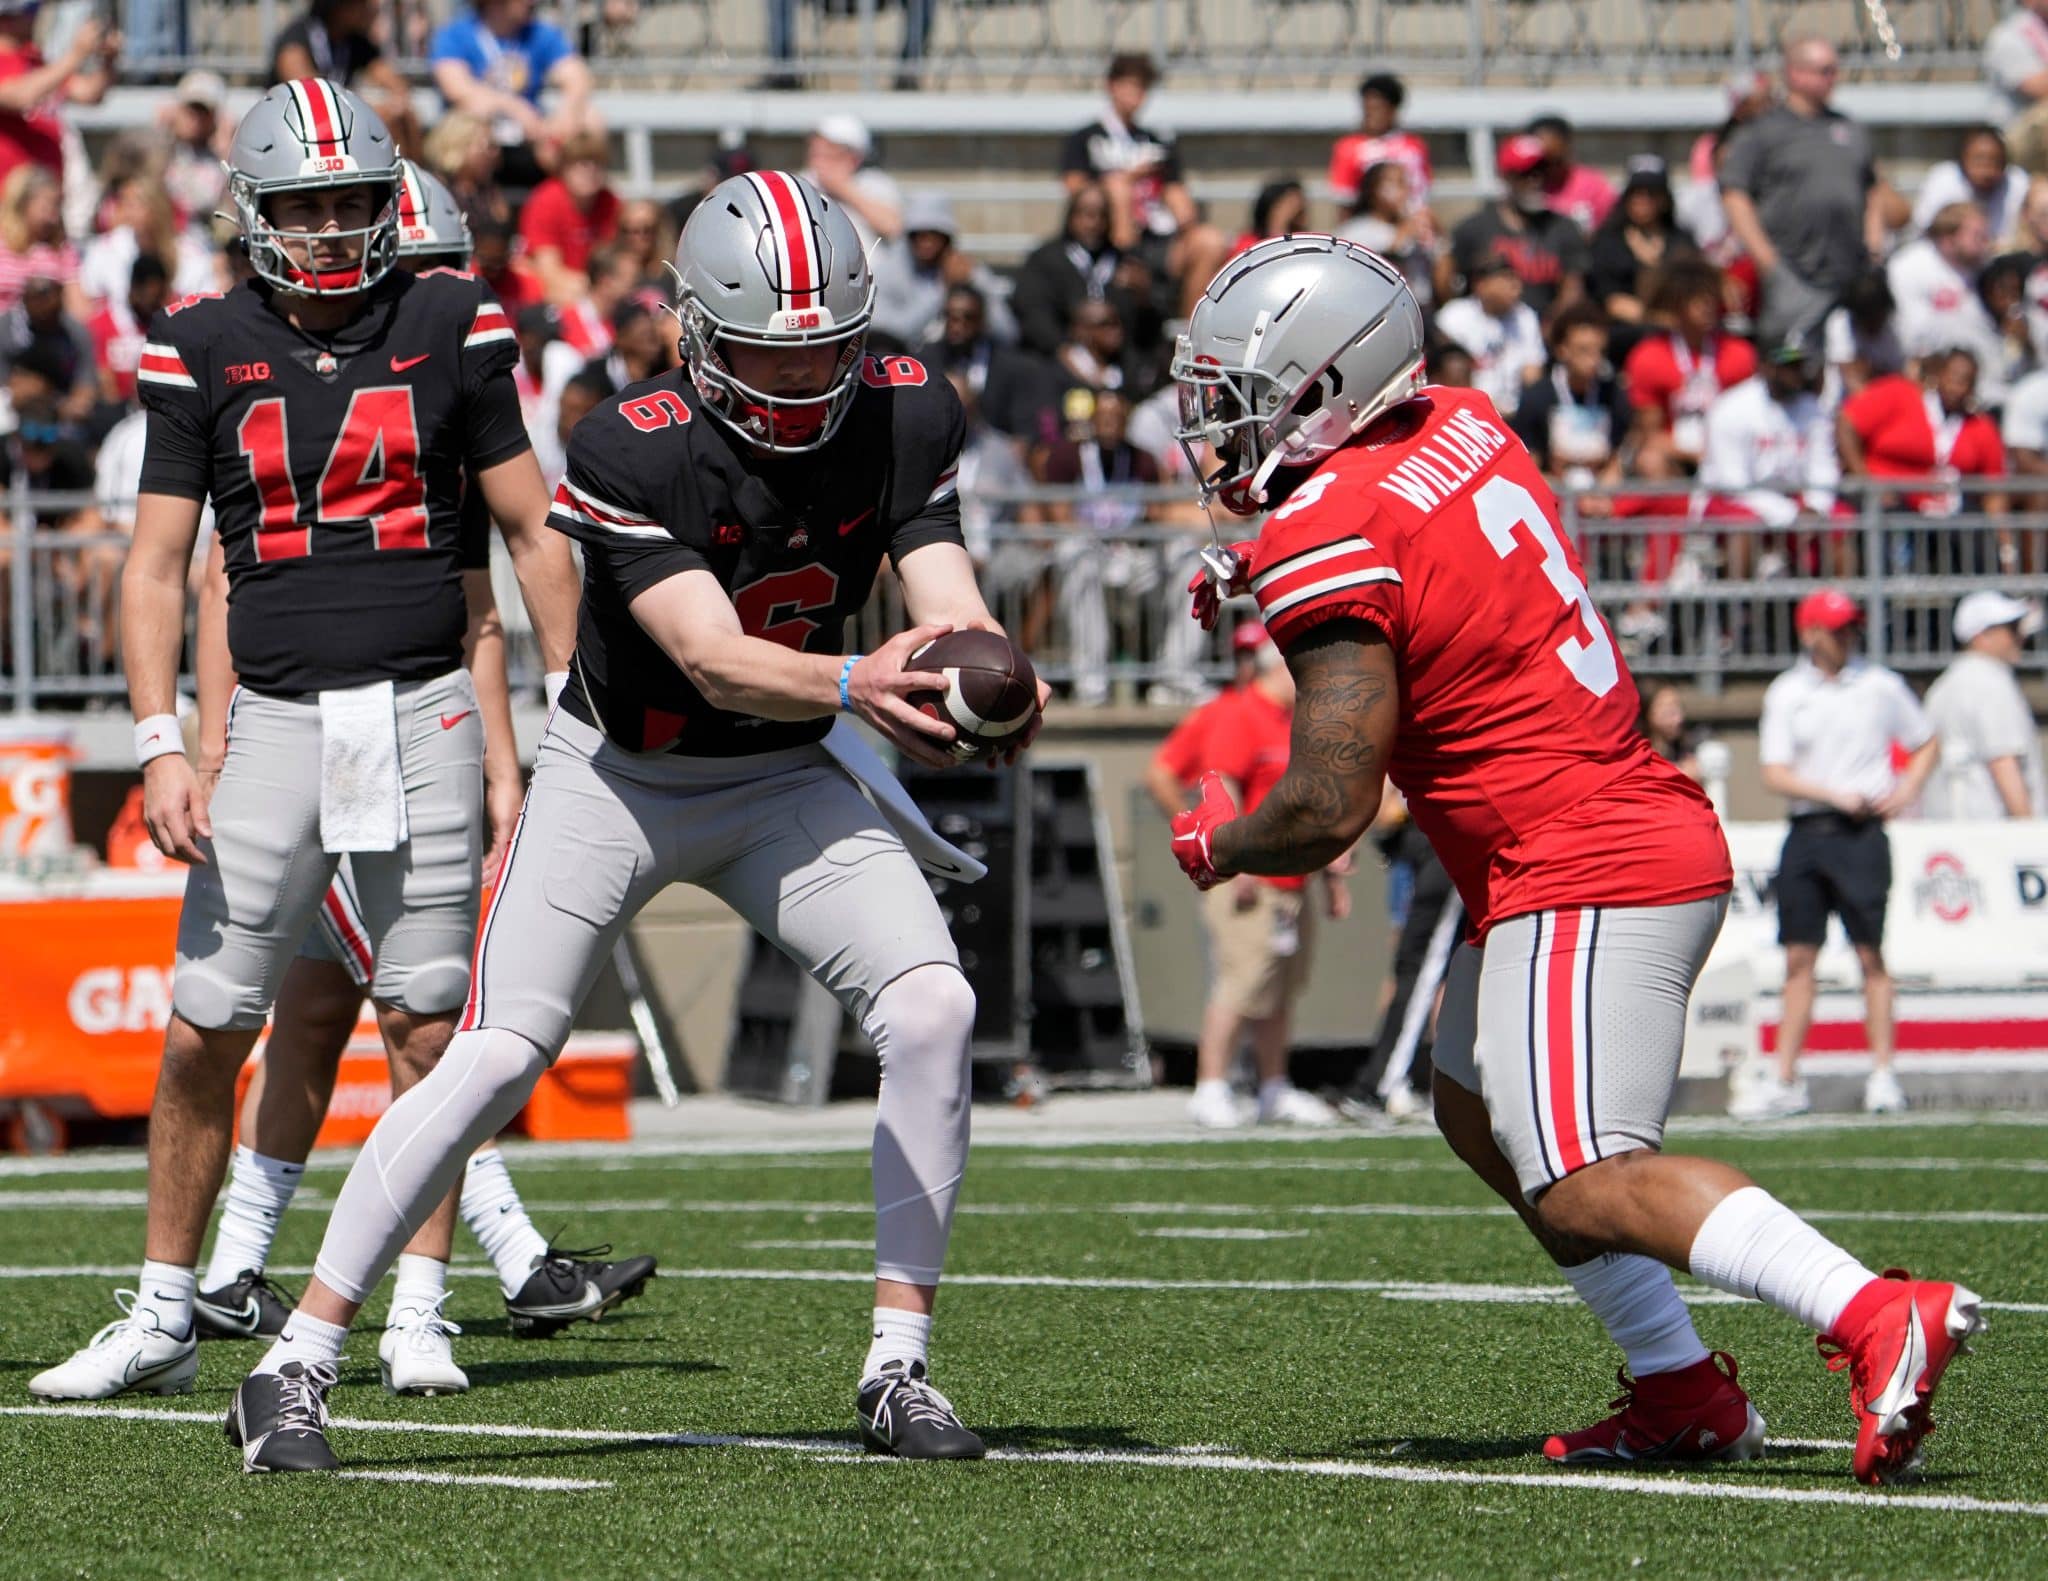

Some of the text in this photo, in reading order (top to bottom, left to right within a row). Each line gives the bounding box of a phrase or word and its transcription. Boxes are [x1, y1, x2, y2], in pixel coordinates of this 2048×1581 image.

[617, 388, 692, 433] 6
[1378, 407, 1507, 514] WILLIAMS
[238, 385, 430, 563] 14
[1472, 474, 1619, 698] 3
[67, 965, 175, 1034] GA
